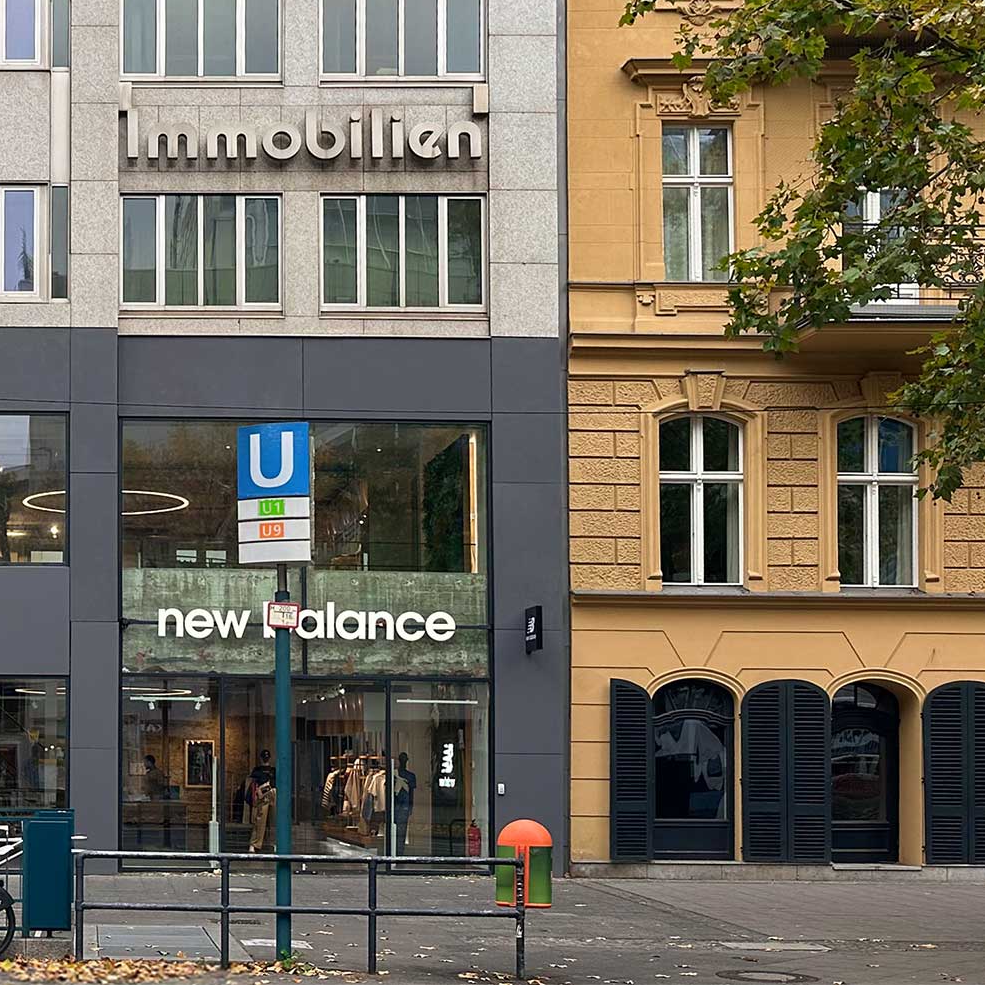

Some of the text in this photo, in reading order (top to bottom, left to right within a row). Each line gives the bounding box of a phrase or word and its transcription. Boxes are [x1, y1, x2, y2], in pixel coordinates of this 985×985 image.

[127, 108, 483, 160] Immobilien
[250, 431, 294, 488] U
[262, 503, 281, 514] U1
[262, 524, 281, 536] U9
[158, 608, 251, 639] new
